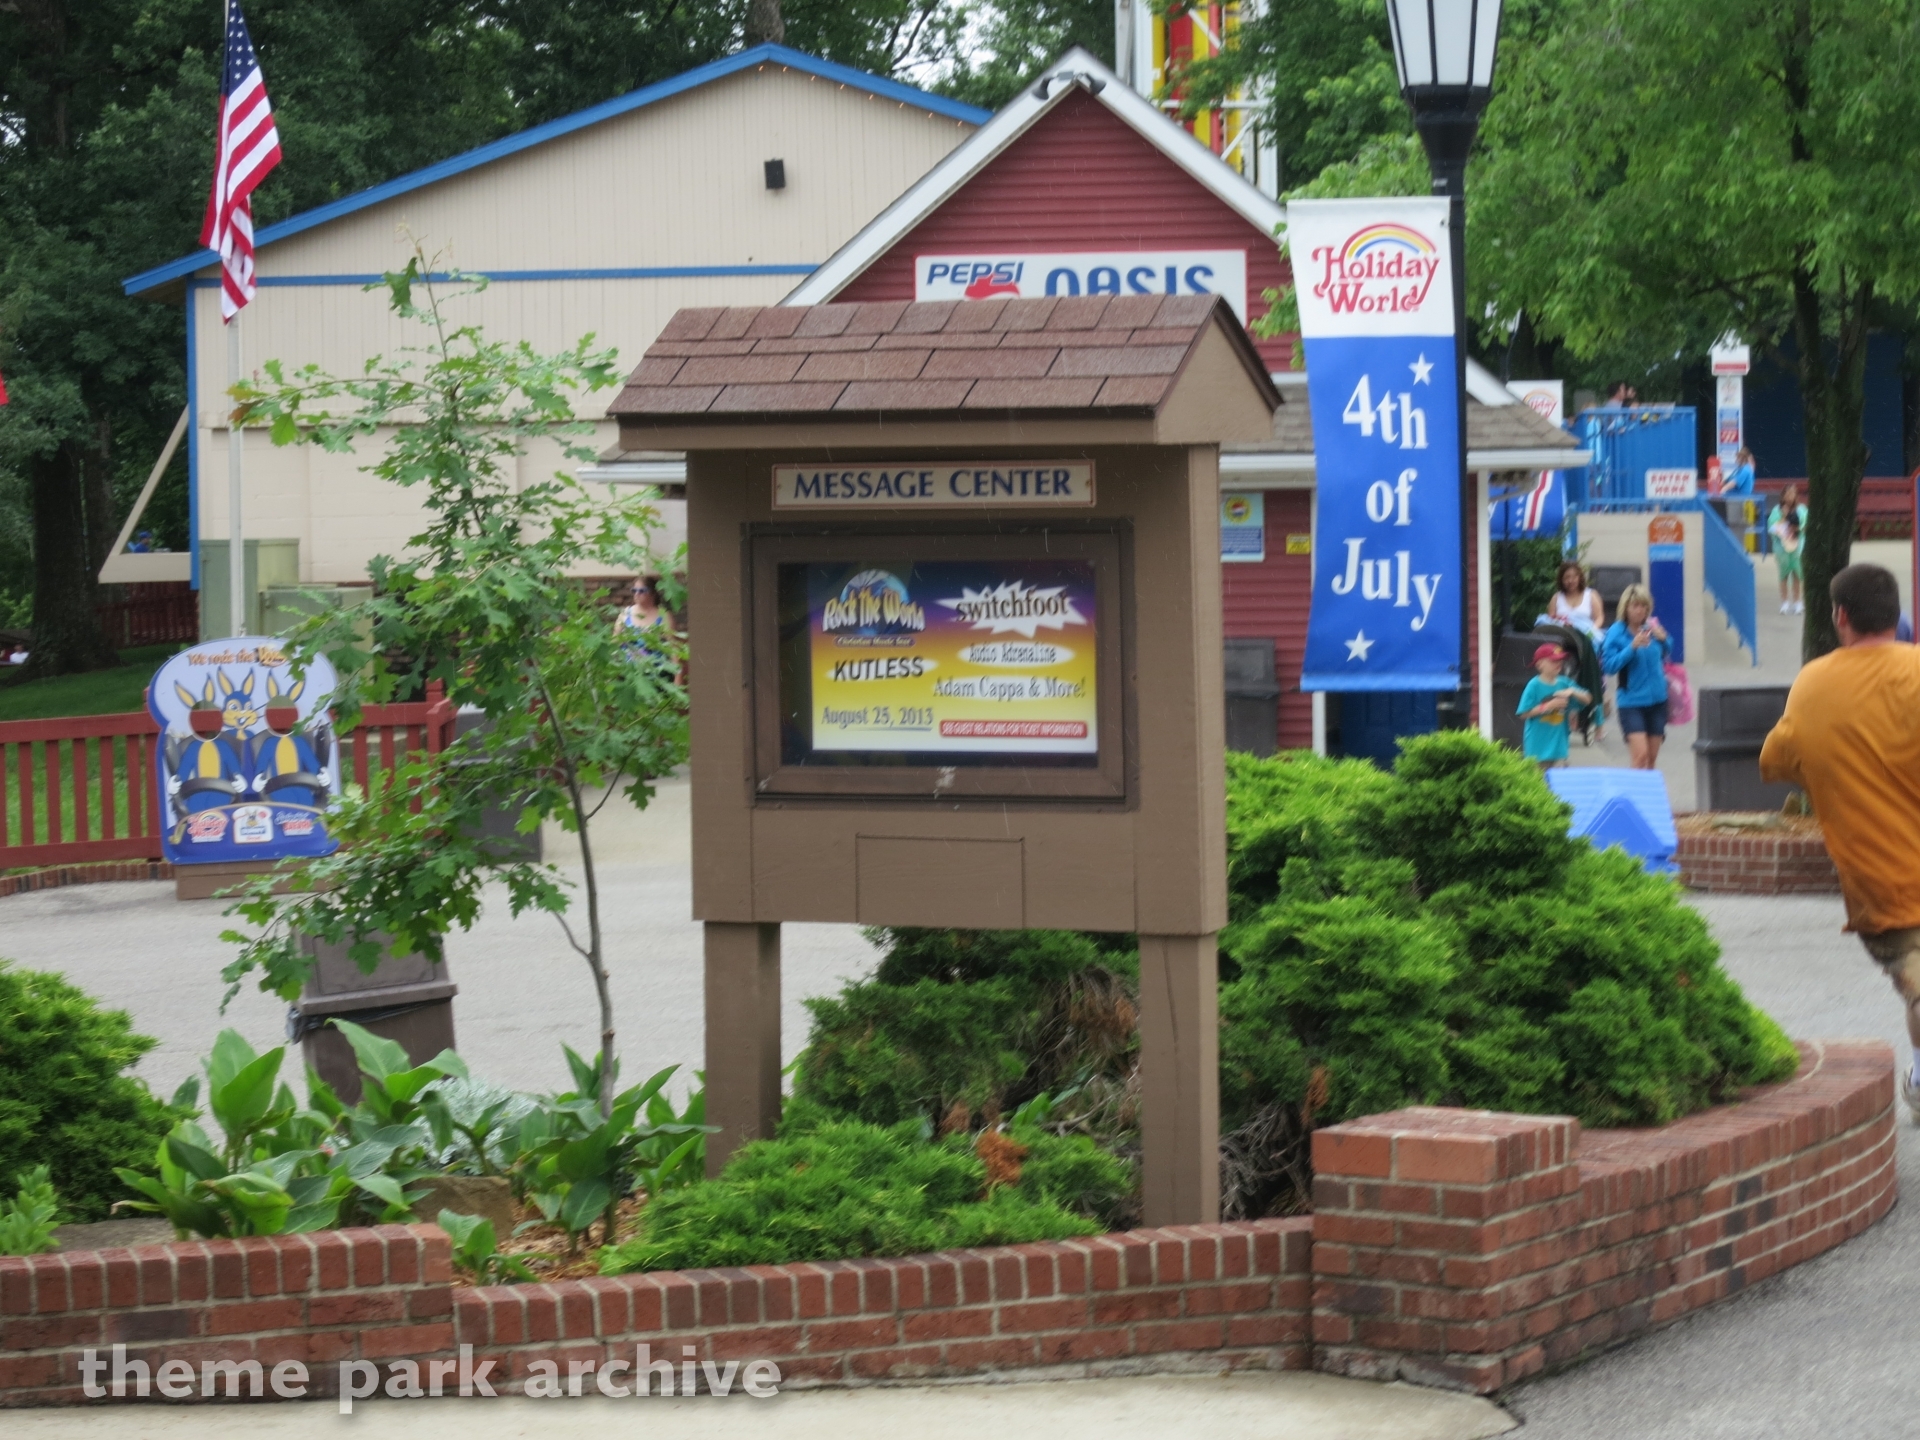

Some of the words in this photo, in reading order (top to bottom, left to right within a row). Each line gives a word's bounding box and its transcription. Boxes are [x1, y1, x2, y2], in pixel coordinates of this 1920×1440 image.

[926, 261, 1025, 286] PEPSI
[1311, 246, 1441, 305] Holiday
[1313, 282, 1420, 313] World
[1342, 373, 1428, 449] 4th
[794, 471, 934, 499] MESSAGE
[949, 469, 1072, 497] CENTER
[1365, 468, 1418, 526] of
[1331, 537, 1443, 632] July
[955, 588, 1071, 622] switchfoot
[834, 656, 924, 682] KUTLESS
[933, 676, 975, 698] Adam
[979, 675, 1024, 702] Cappa
[1028, 676, 1041, 697] &
[1043, 676, 1086, 698] More!
[821, 706, 868, 729] August
[872, 706, 894, 728] 25,
[899, 706, 934, 725] 2013
